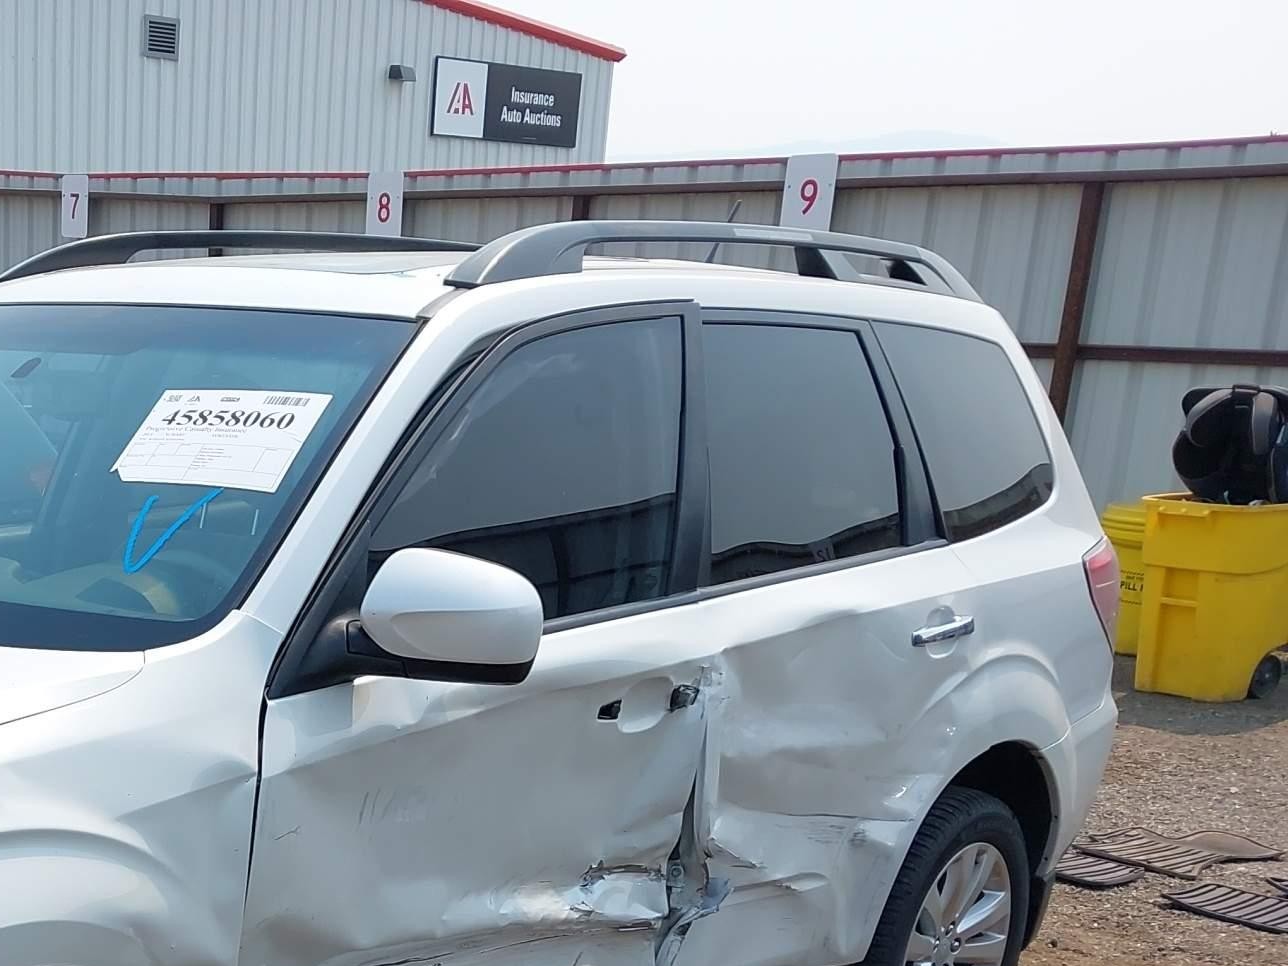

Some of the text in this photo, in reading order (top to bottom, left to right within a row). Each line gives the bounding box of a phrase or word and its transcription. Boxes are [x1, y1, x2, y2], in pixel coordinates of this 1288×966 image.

[511, 86, 554, 106] Insurance
[500, 105, 562, 127] Auto Auctions
[70, 193, 80, 219] 7
[377, 192, 391, 223] 8
[800, 179, 818, 215] 9
[161, 409, 295, 430] 45858060
[1120, 580, 1137, 591] PILL
